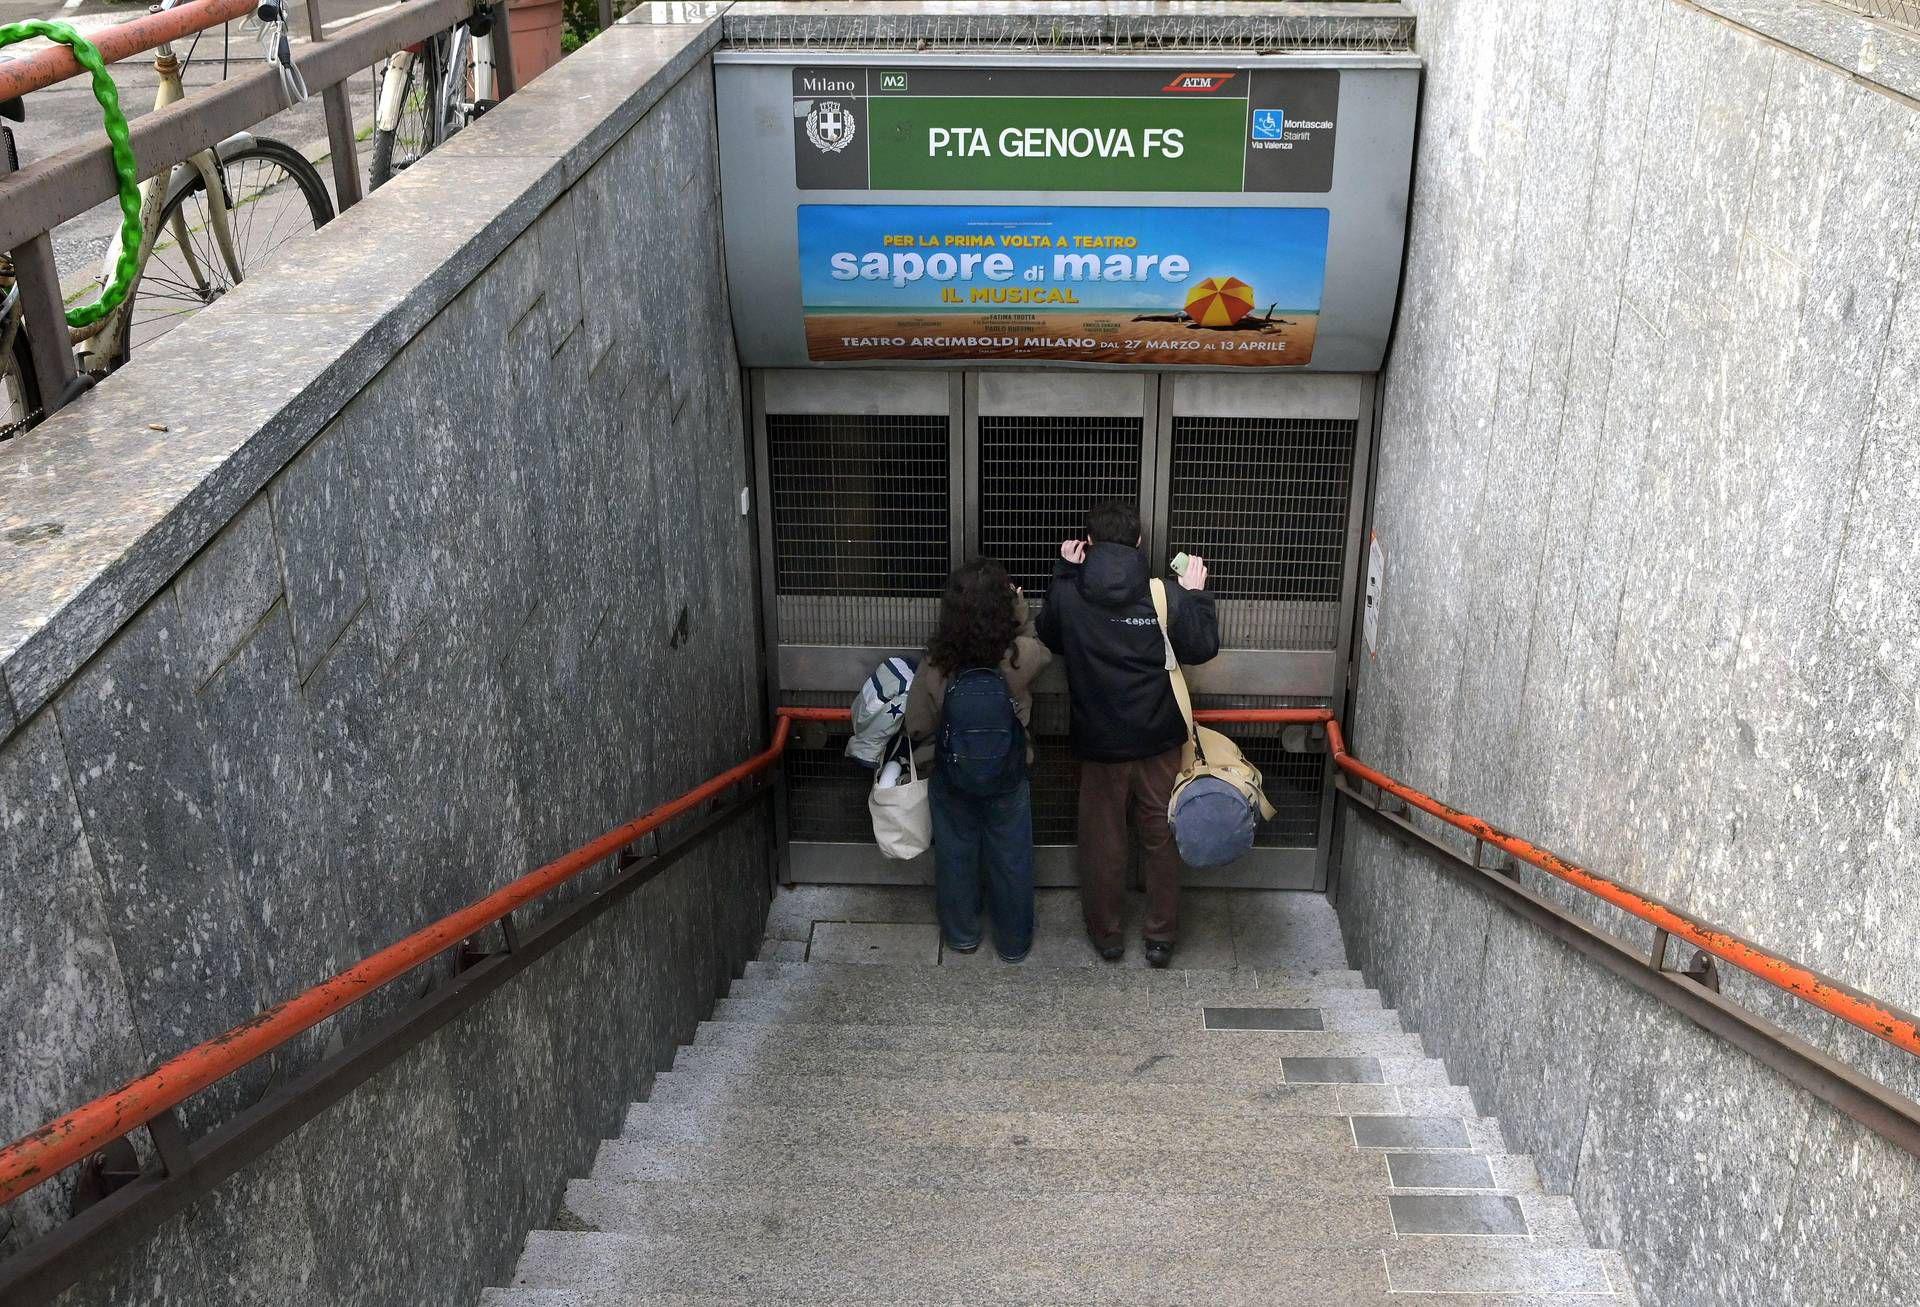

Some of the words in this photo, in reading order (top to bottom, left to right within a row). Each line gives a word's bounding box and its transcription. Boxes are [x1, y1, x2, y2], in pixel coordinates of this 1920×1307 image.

[803, 77, 855, 91] Milano
[883, 76, 905, 87] M2
[1183, 78, 1212, 88] ATM
[1284, 120, 1333, 129] Montascale
[1283, 132, 1310, 141] Stairlift
[929, 128, 991, 157] P.TA
[999, 128, 1136, 158] GENOVA
[1143, 129, 1184, 159] FS
[1252, 141, 1263, 149] Via
[884, 236, 915, 247] PER
[920, 236, 940, 247] LA
[945, 236, 996, 247] PRIMA
[1001, 236, 1051, 248] VOLTA
[1056, 237, 1069, 248] A
[1073, 236, 1138, 248] TEATRO
[831, 253, 1015, 288] sapore
[1024, 266, 1044, 282] di
[1053, 254, 1190, 283] mare
[942, 288, 963, 303] IL
[970, 288, 1079, 304] MUSICAL
[842, 336, 905, 346] TEATRO
[911, 336, 1019, 347] ARCIMBOLDI
[1024, 337, 1096, 348] MILANO
[1100, 341, 1120, 349] DAL
[1124, 340, 1141, 350] 27
[1146, 340, 1200, 350] MARZO
[1204, 343, 1217, 351] AL
[1221, 341, 1234, 350] 13
[1240, 341, 1286, 351] APRILE
